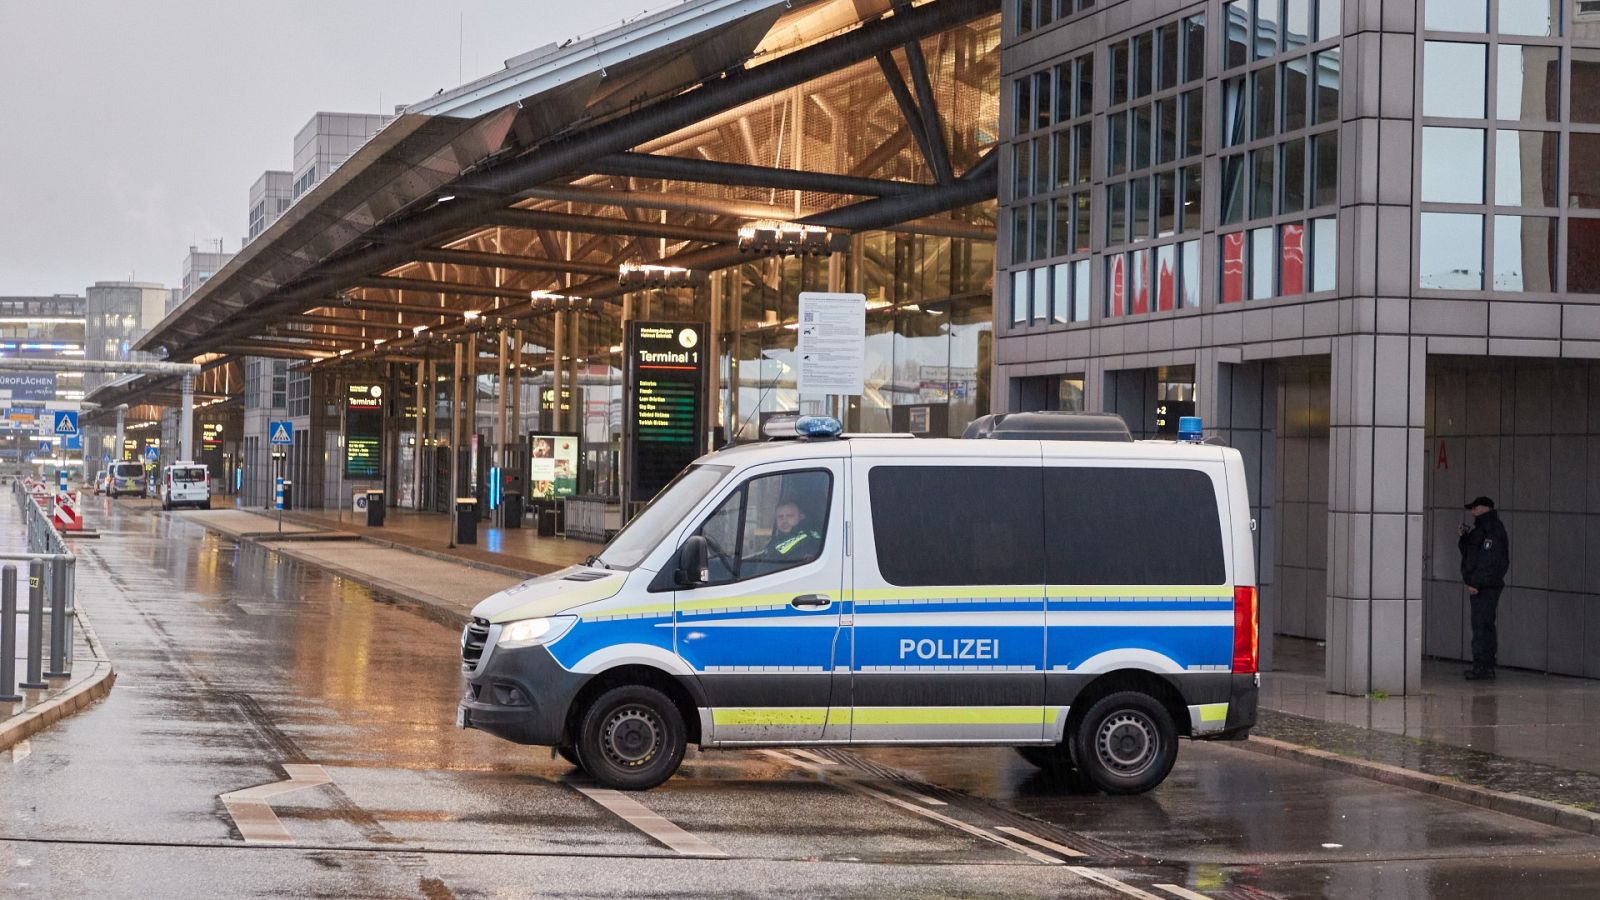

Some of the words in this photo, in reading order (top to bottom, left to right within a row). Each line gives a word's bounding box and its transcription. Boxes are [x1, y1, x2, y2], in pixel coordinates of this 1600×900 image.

[640, 350, 688, 363] Terminal
[692, 351, 698, 363] 1
[0, 375, 53, 385] ÜROFLÄCHEN
[349, 397, 376, 406] Terminal
[378, 398, 382, 406] 1
[1437, 440, 1448, 469] A
[900, 638, 999, 659] POLIZEI
